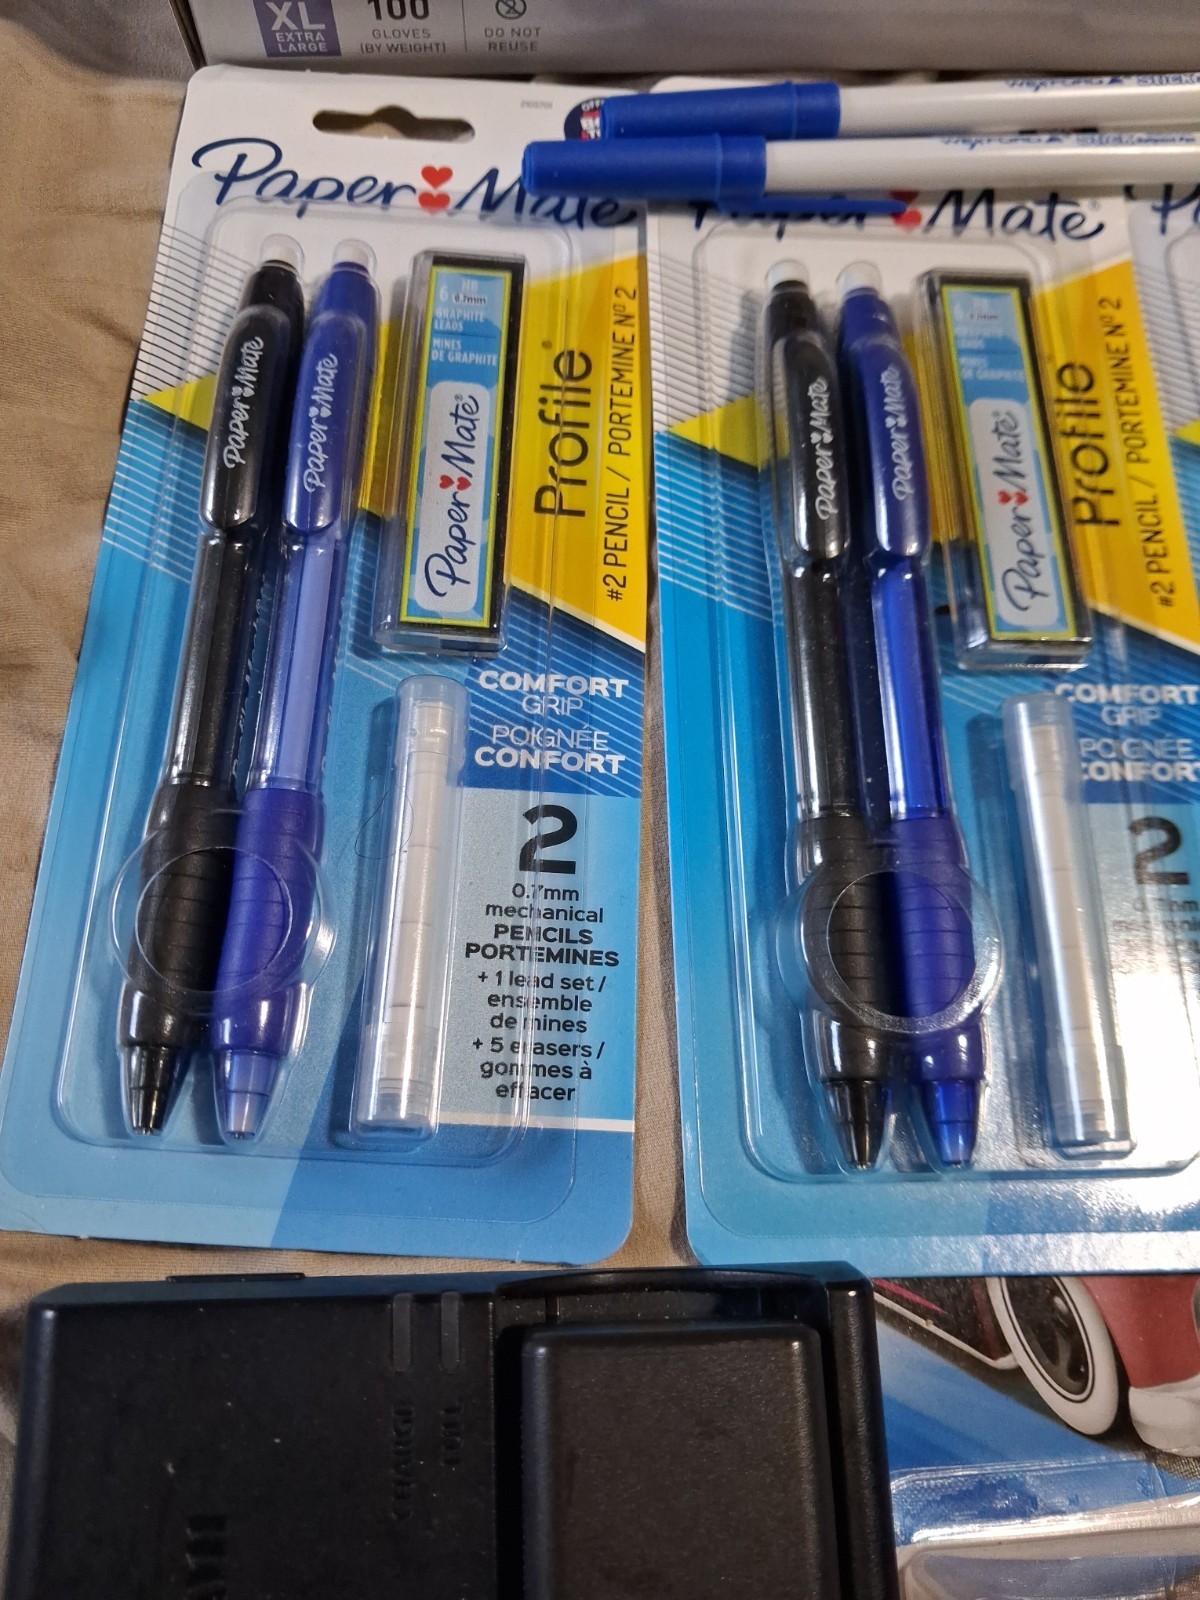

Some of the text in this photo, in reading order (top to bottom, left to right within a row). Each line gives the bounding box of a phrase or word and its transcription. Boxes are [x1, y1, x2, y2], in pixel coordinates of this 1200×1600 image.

[266, 1, 326, 31] XL
[368, 0, 430, 20] 100
[275, 31, 325, 42] EXTRA
[372, 28, 431, 39] GLOVES
[484, 27, 541, 38] DO NOT
[488, 40, 539, 51] REUSE
[278, 42, 328, 53] LARGE
[360, 43, 446, 54] (BY WEIGHT)
[191, 137, 416, 219] Paper
[923, 188, 1104, 242] Mate
[432, 338, 462, 350] MINES
[431, 349, 498, 367] DE GRAPHITE
[223, 336, 264, 469] Paper Mate
[608, 332, 634, 457] PORTEMINE
[1106, 343, 1149, 465] PORTEMINE
[303, 353, 339, 493] Paper Mate
[534, 350, 592, 518] Profile
[807, 376, 838, 520] Paper Mate
[1055, 362, 1121, 527] Profile
[890, 427, 914, 501] Paper
[424, 395, 480, 597] Paper Mate
[992, 410, 1050, 612] Paper Mate
[604, 488, 629, 568] PENCIL
[1138, 496, 1171, 576] PENCIL
[602, 574, 627, 602] #2
[1150, 581, 1175, 608] #2
[478, 670, 629, 698] COMFORT
[1055, 683, 1199, 705] COMFORT
[521, 695, 584, 716] GRIP
[1101, 706, 1161, 726] GRIP
[492, 724, 609, 751] POIGNÉE
[474, 746, 626, 774] CONFORT
[1080, 762, 1200, 782] ONFORT
[519, 804, 578, 874] 2
[1130, 816, 1190, 885] 2
[485, 903, 603, 923] mechanical
[494, 924, 594, 945] PENCILS
[465, 942, 620, 967] PORTEMINES
[509, 971, 554, 989] lead
[560, 977, 594, 991] set
[487, 993, 593, 1012] ensemble
[490, 1013, 517, 1029] de
[579, 1061, 592, 1080] à
